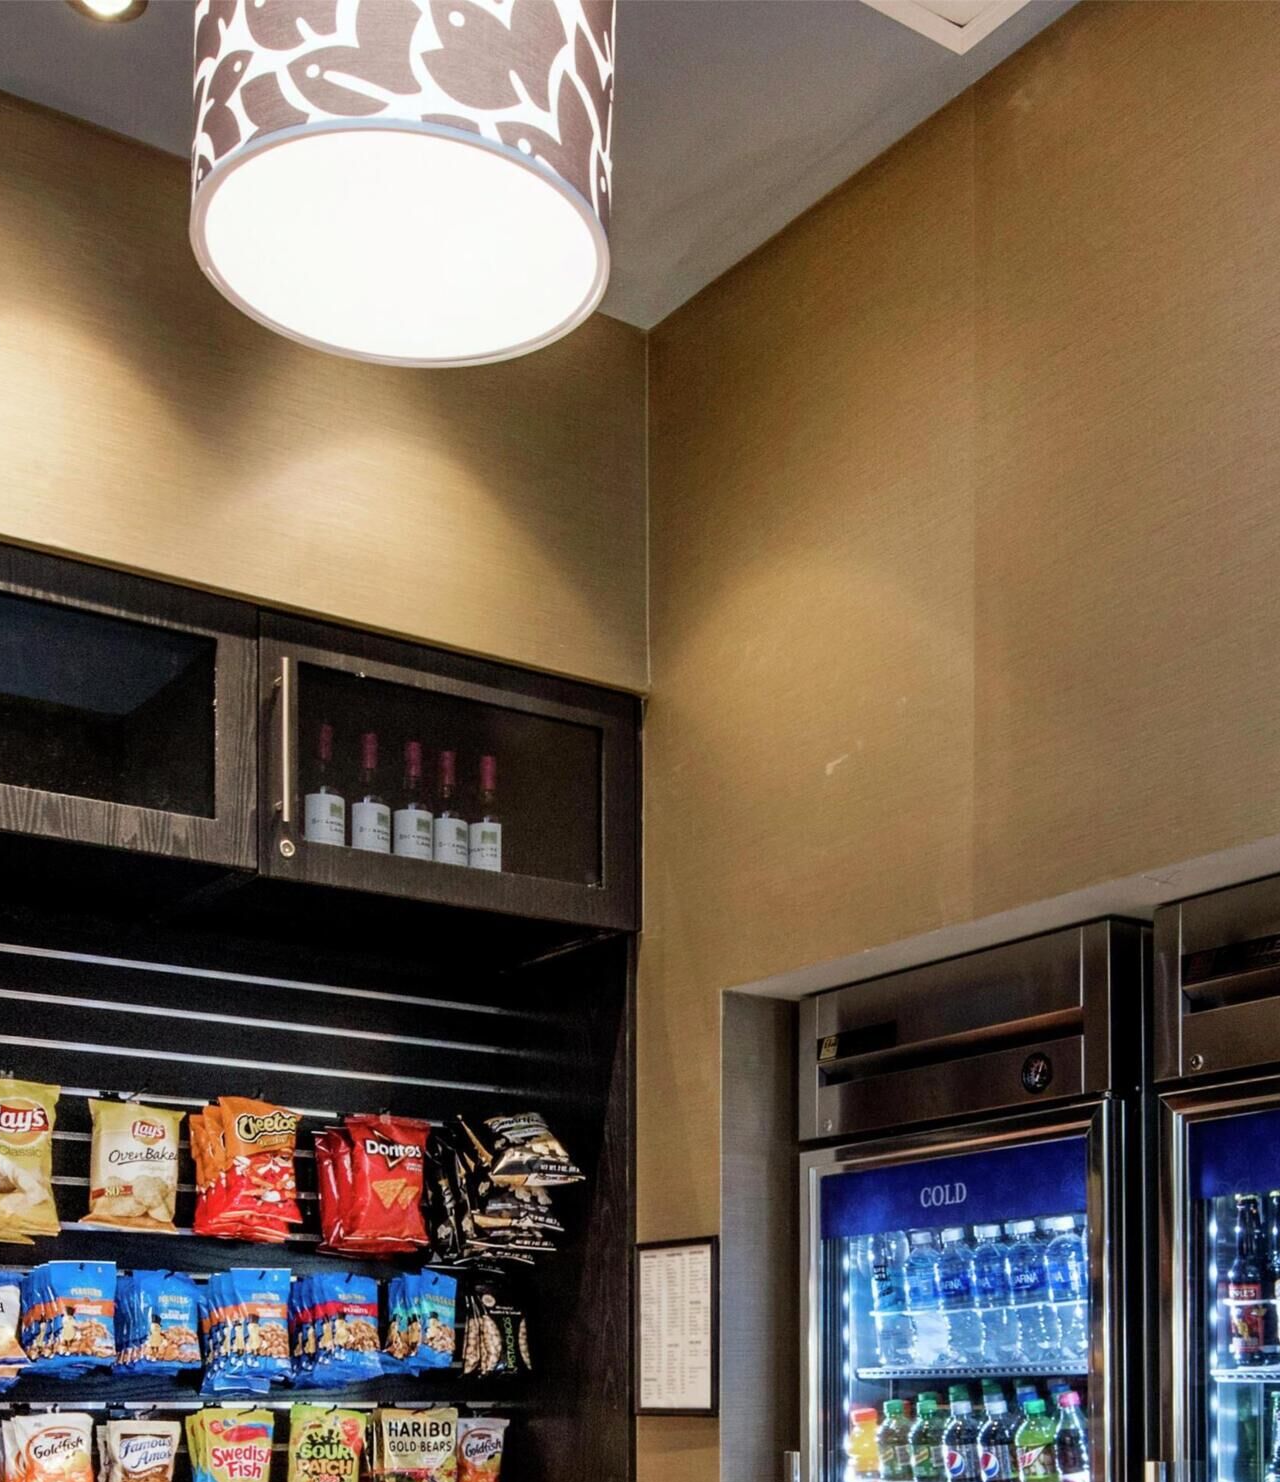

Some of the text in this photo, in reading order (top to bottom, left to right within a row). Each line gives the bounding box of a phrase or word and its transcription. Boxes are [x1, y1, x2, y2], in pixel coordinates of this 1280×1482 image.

[238, 1112, 297, 1140] Cheetos
[108, 1149, 145, 1164] Oven
[365, 1138, 422, 1158] Doritos
[920, 1182, 968, 1208] COLD
[503, 1317, 514, 1369] PISTACHIOS
[388, 1421, 452, 1437] HARIBO
[33, 1435, 84, 1459] Goldfish
[119, 1437, 172, 1459] Famous
[299, 1443, 348, 1459] SOUR
[465, 1438, 502, 1456] Goldfish
[227, 1461, 262, 1479] Fish
[297, 1459, 353, 1475] PATCH
